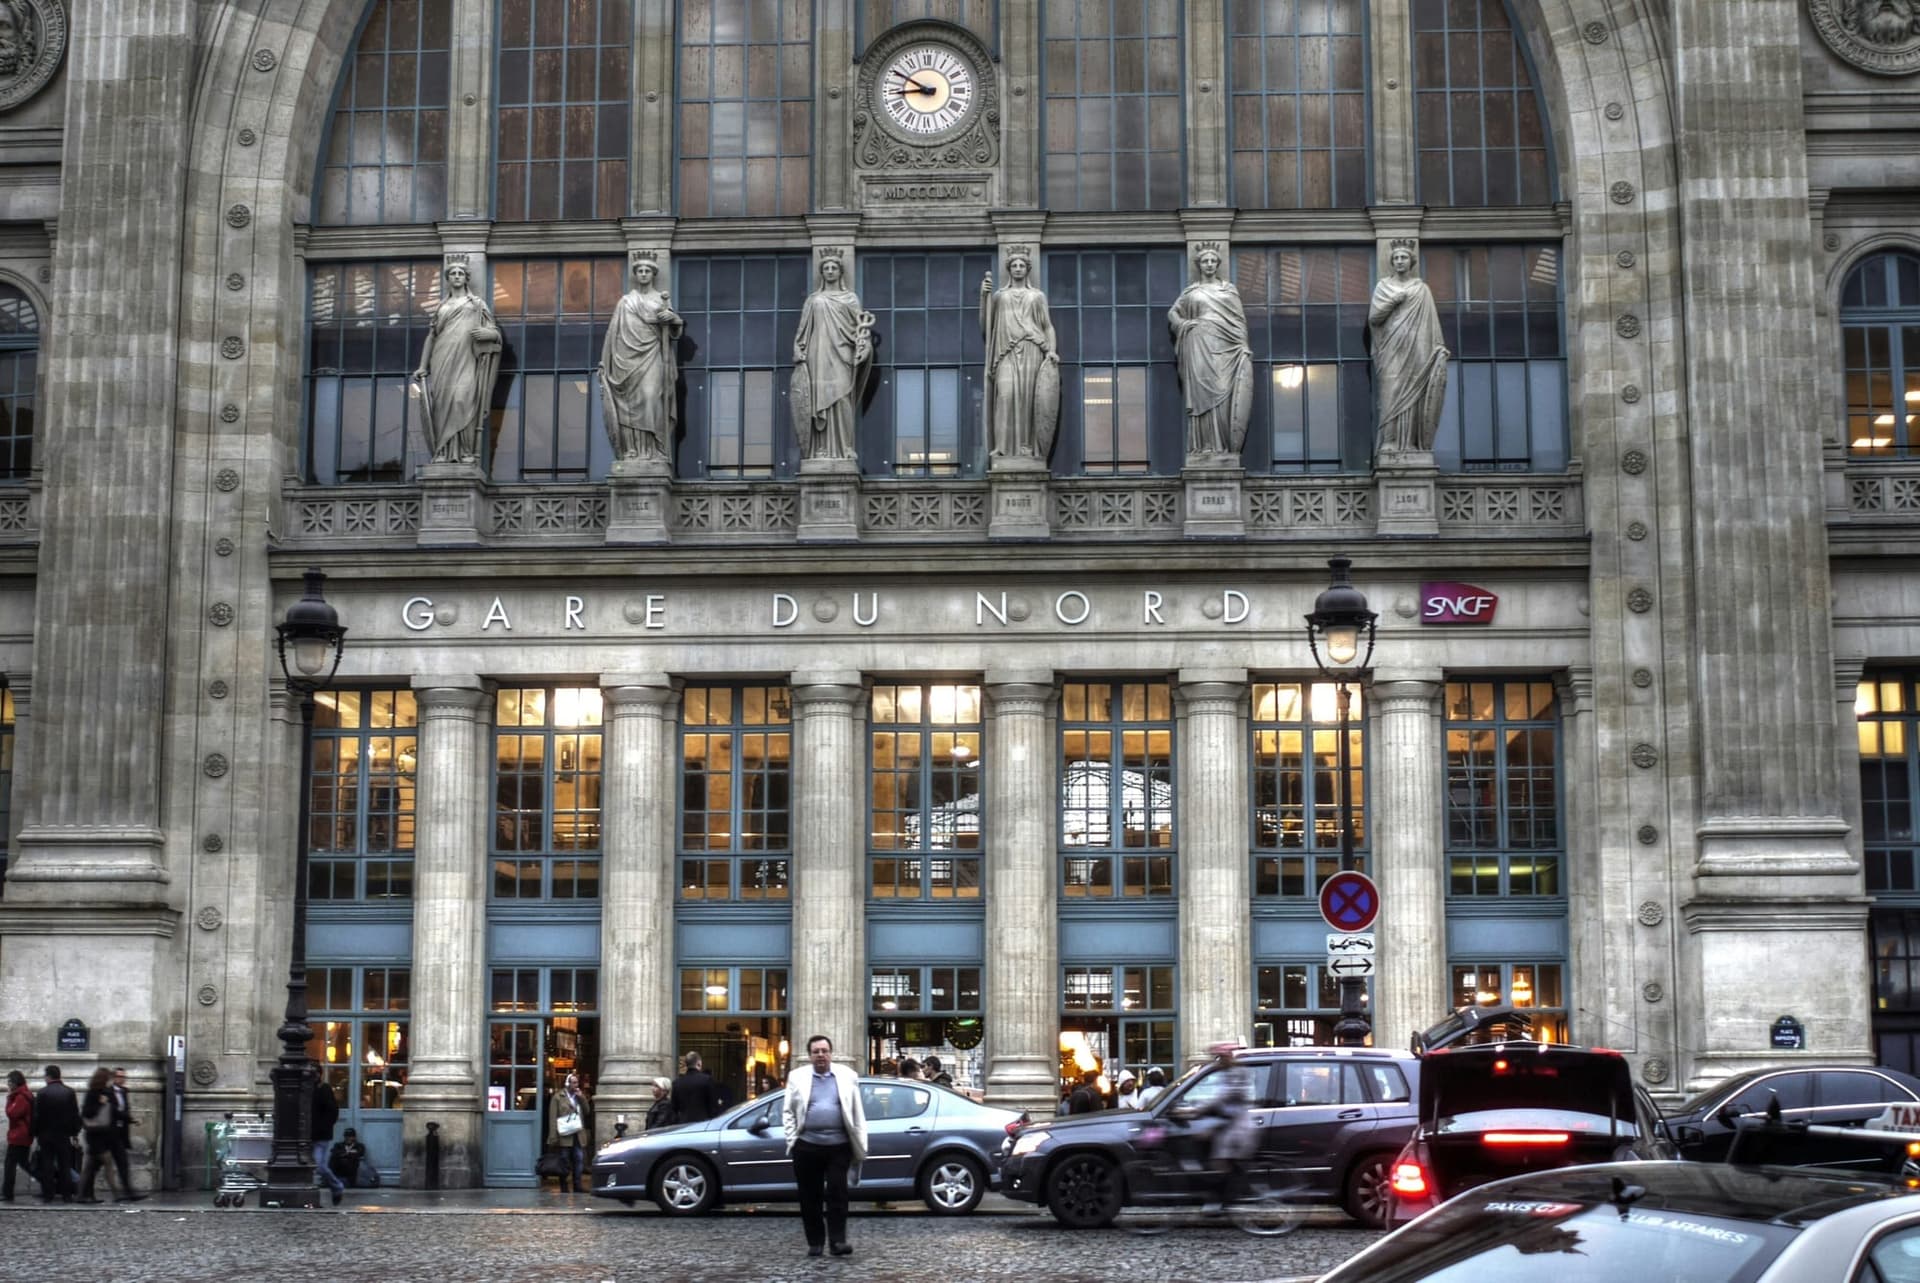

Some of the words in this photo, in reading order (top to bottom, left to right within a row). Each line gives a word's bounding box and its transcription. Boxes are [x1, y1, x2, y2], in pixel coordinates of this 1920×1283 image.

[884, 184, 968, 200] MDCCCLXIV
[402, 594, 665, 631] GARE
[772, 592, 879, 628] DU
[976, 590, 1250, 626] NORD
[1424, 596, 1494, 617] SNCF
[1484, 1202, 1533, 1212] TAXIS
[1663, 1220, 1748, 1244] AFFAIRES
